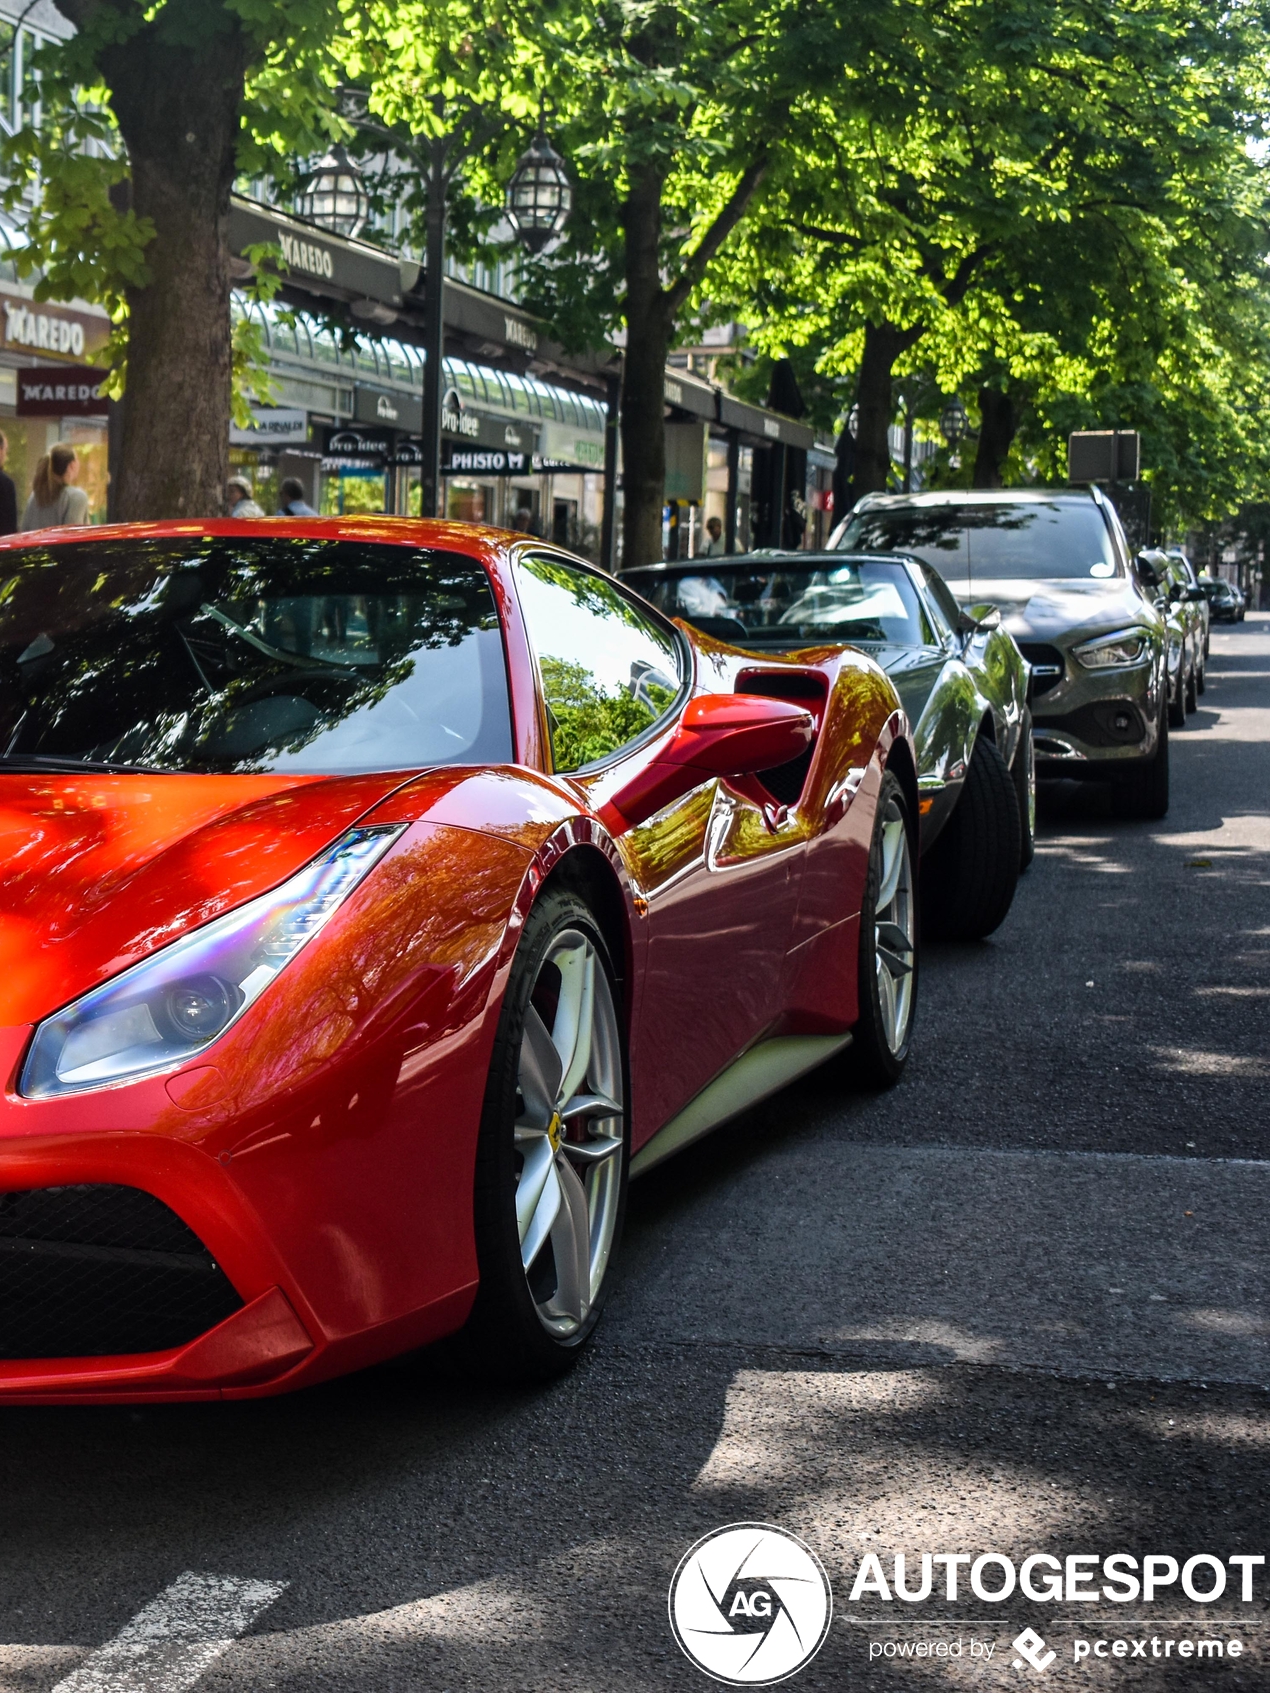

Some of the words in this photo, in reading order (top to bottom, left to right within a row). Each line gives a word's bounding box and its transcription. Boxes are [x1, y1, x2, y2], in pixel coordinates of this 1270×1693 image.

[278, 231, 333, 278] MAREDO
[4, 301, 85, 356] MAREDO
[439, 453, 505, 469] PHISTO
